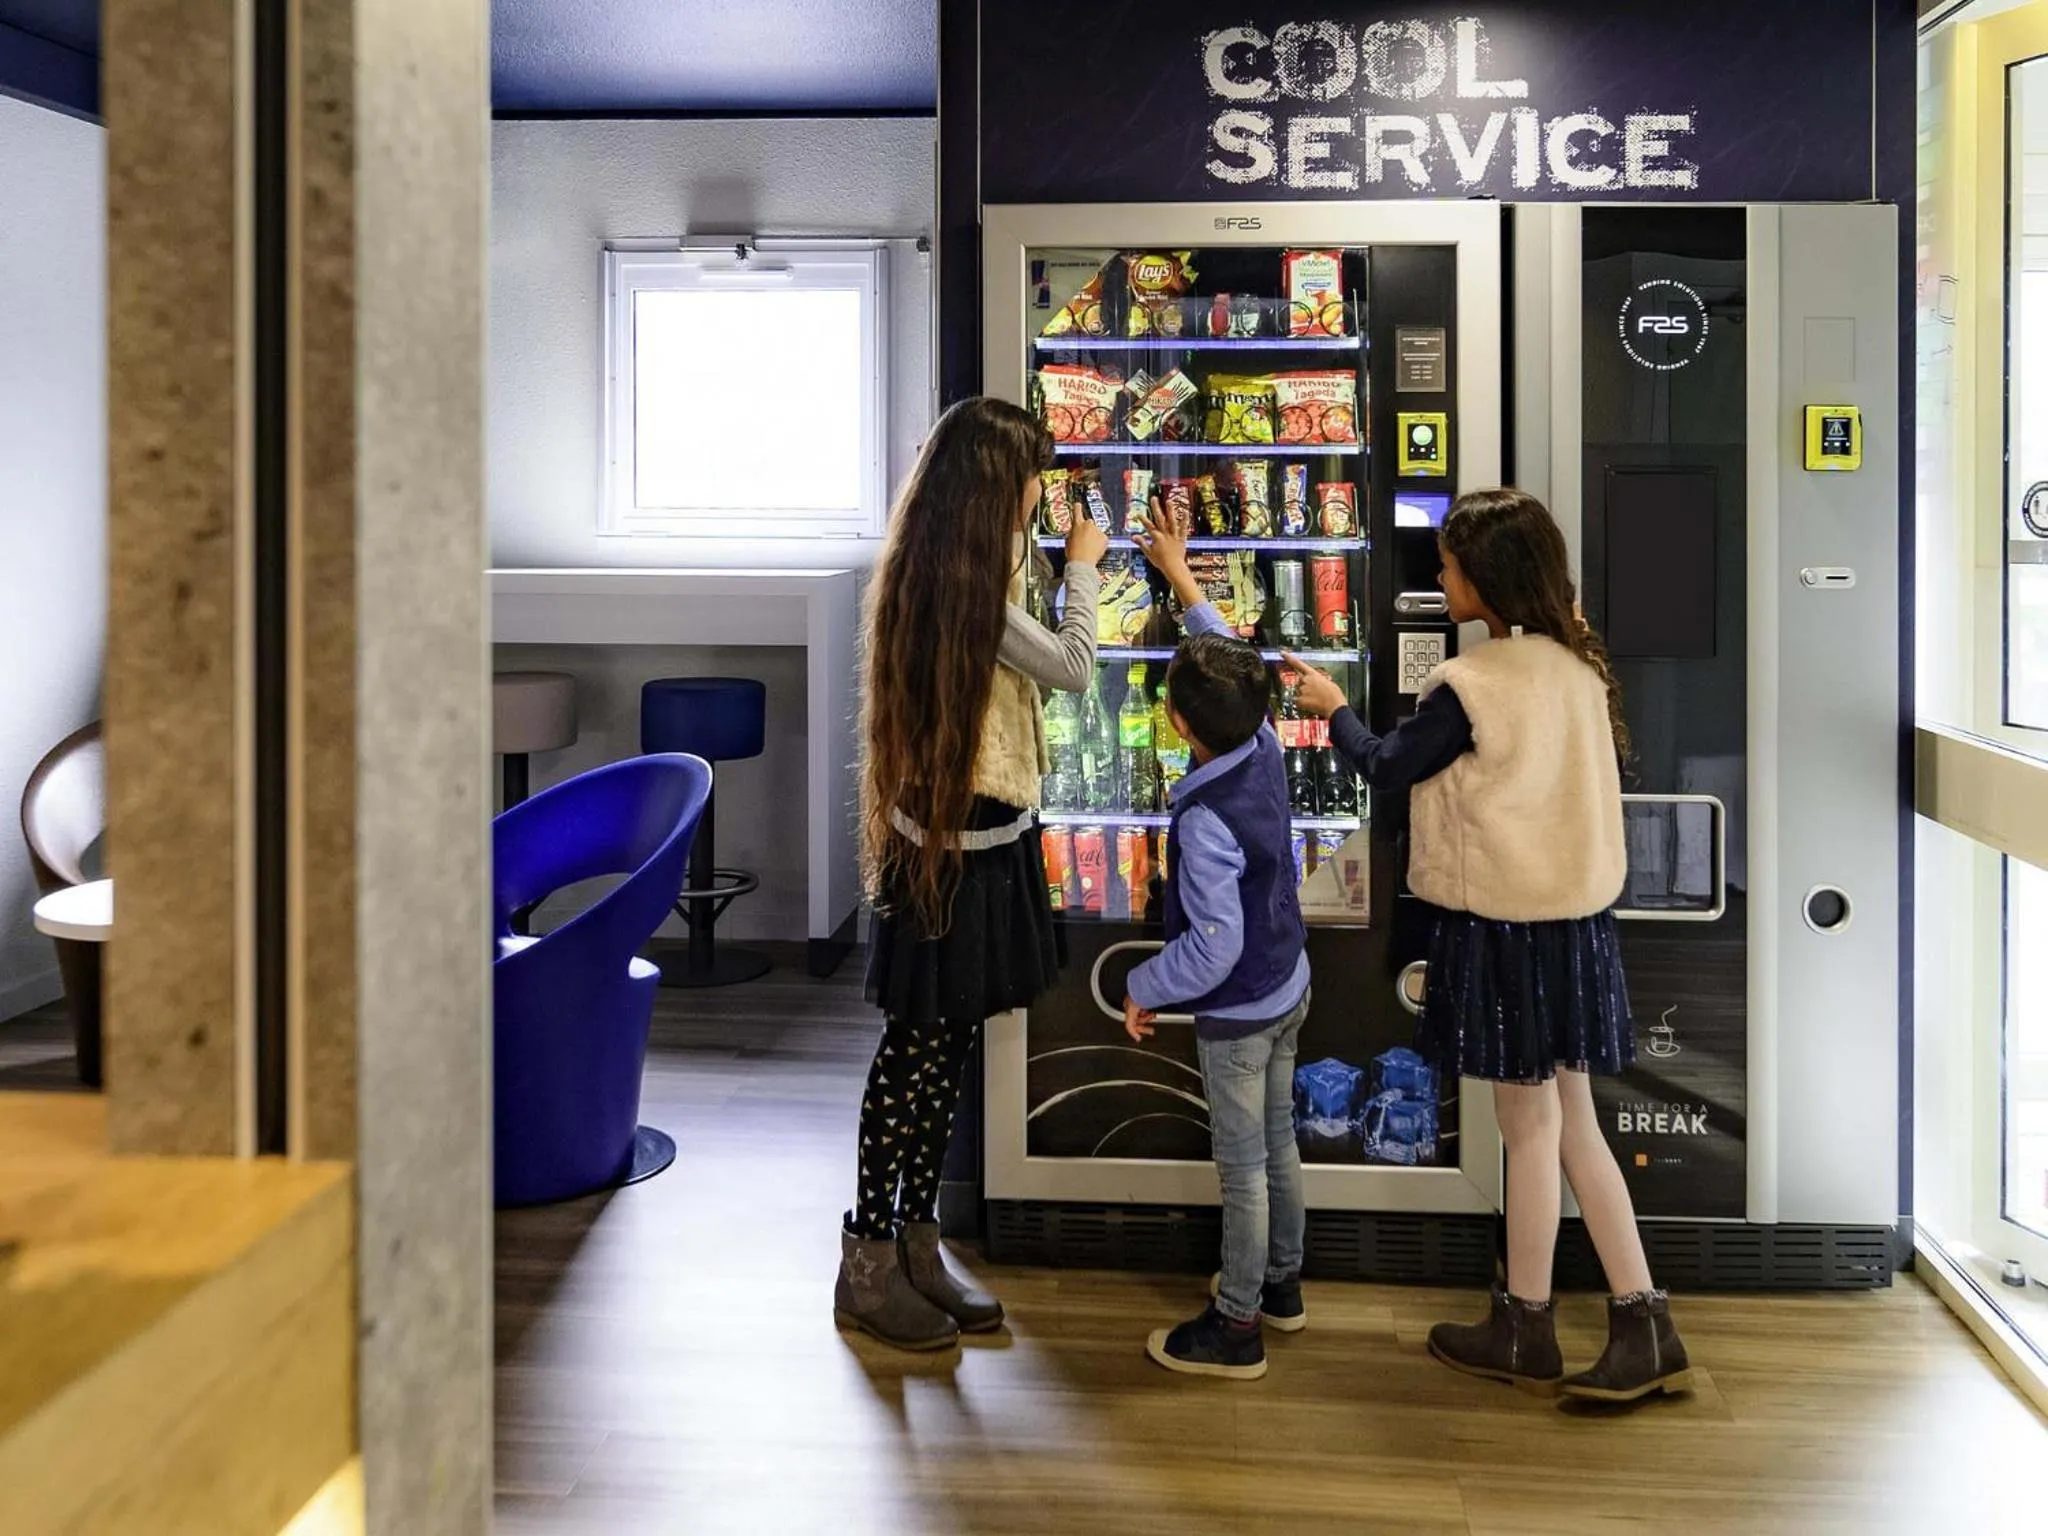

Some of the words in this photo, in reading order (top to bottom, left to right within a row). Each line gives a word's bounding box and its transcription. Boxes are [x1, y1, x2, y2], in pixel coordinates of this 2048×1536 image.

[1199, 17, 1529, 101] COOL
[1205, 107, 1699, 191] SERVICE
[1058, 377, 1107, 395] HARIBO
[1619, 1102, 1655, 1113] TIME
[1699, 1103, 1708, 1114] A
[1617, 1112, 1708, 1135] BREAK
